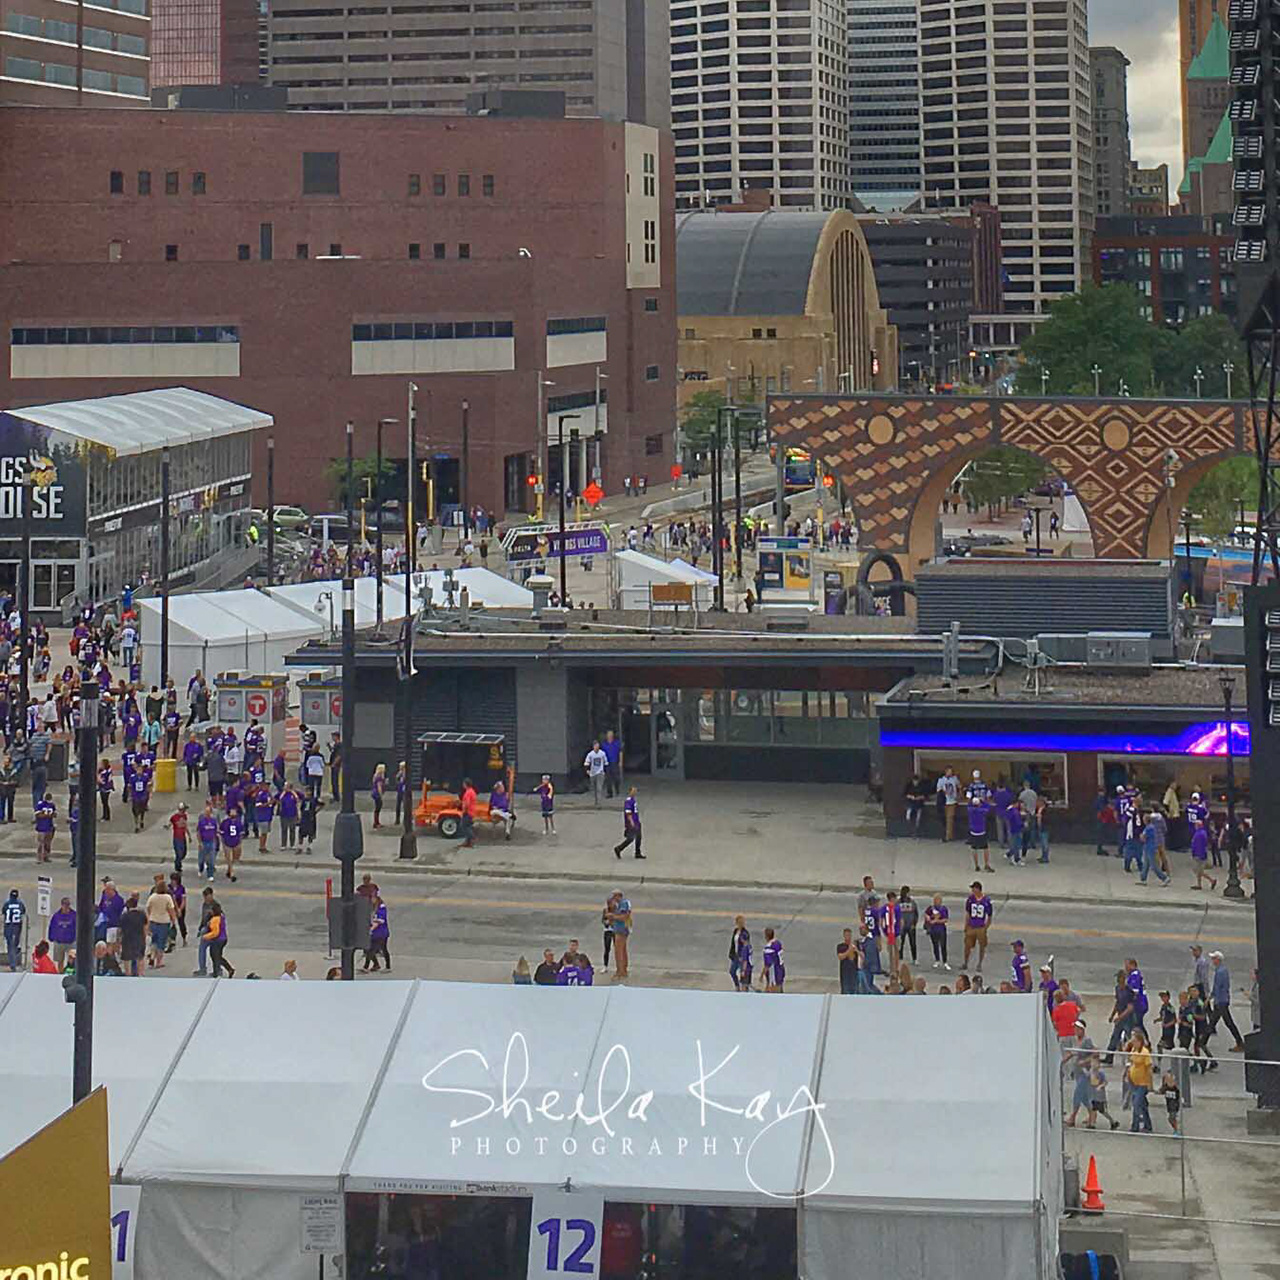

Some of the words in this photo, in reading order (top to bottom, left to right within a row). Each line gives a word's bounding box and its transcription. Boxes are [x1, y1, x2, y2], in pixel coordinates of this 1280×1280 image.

[578, 535, 601, 549] VILLAGE
[230, 825, 237, 836] 5
[4, 908, 21, 923] 12
[971, 904, 985, 918] 69
[537, 1218, 596, 1274] 12
